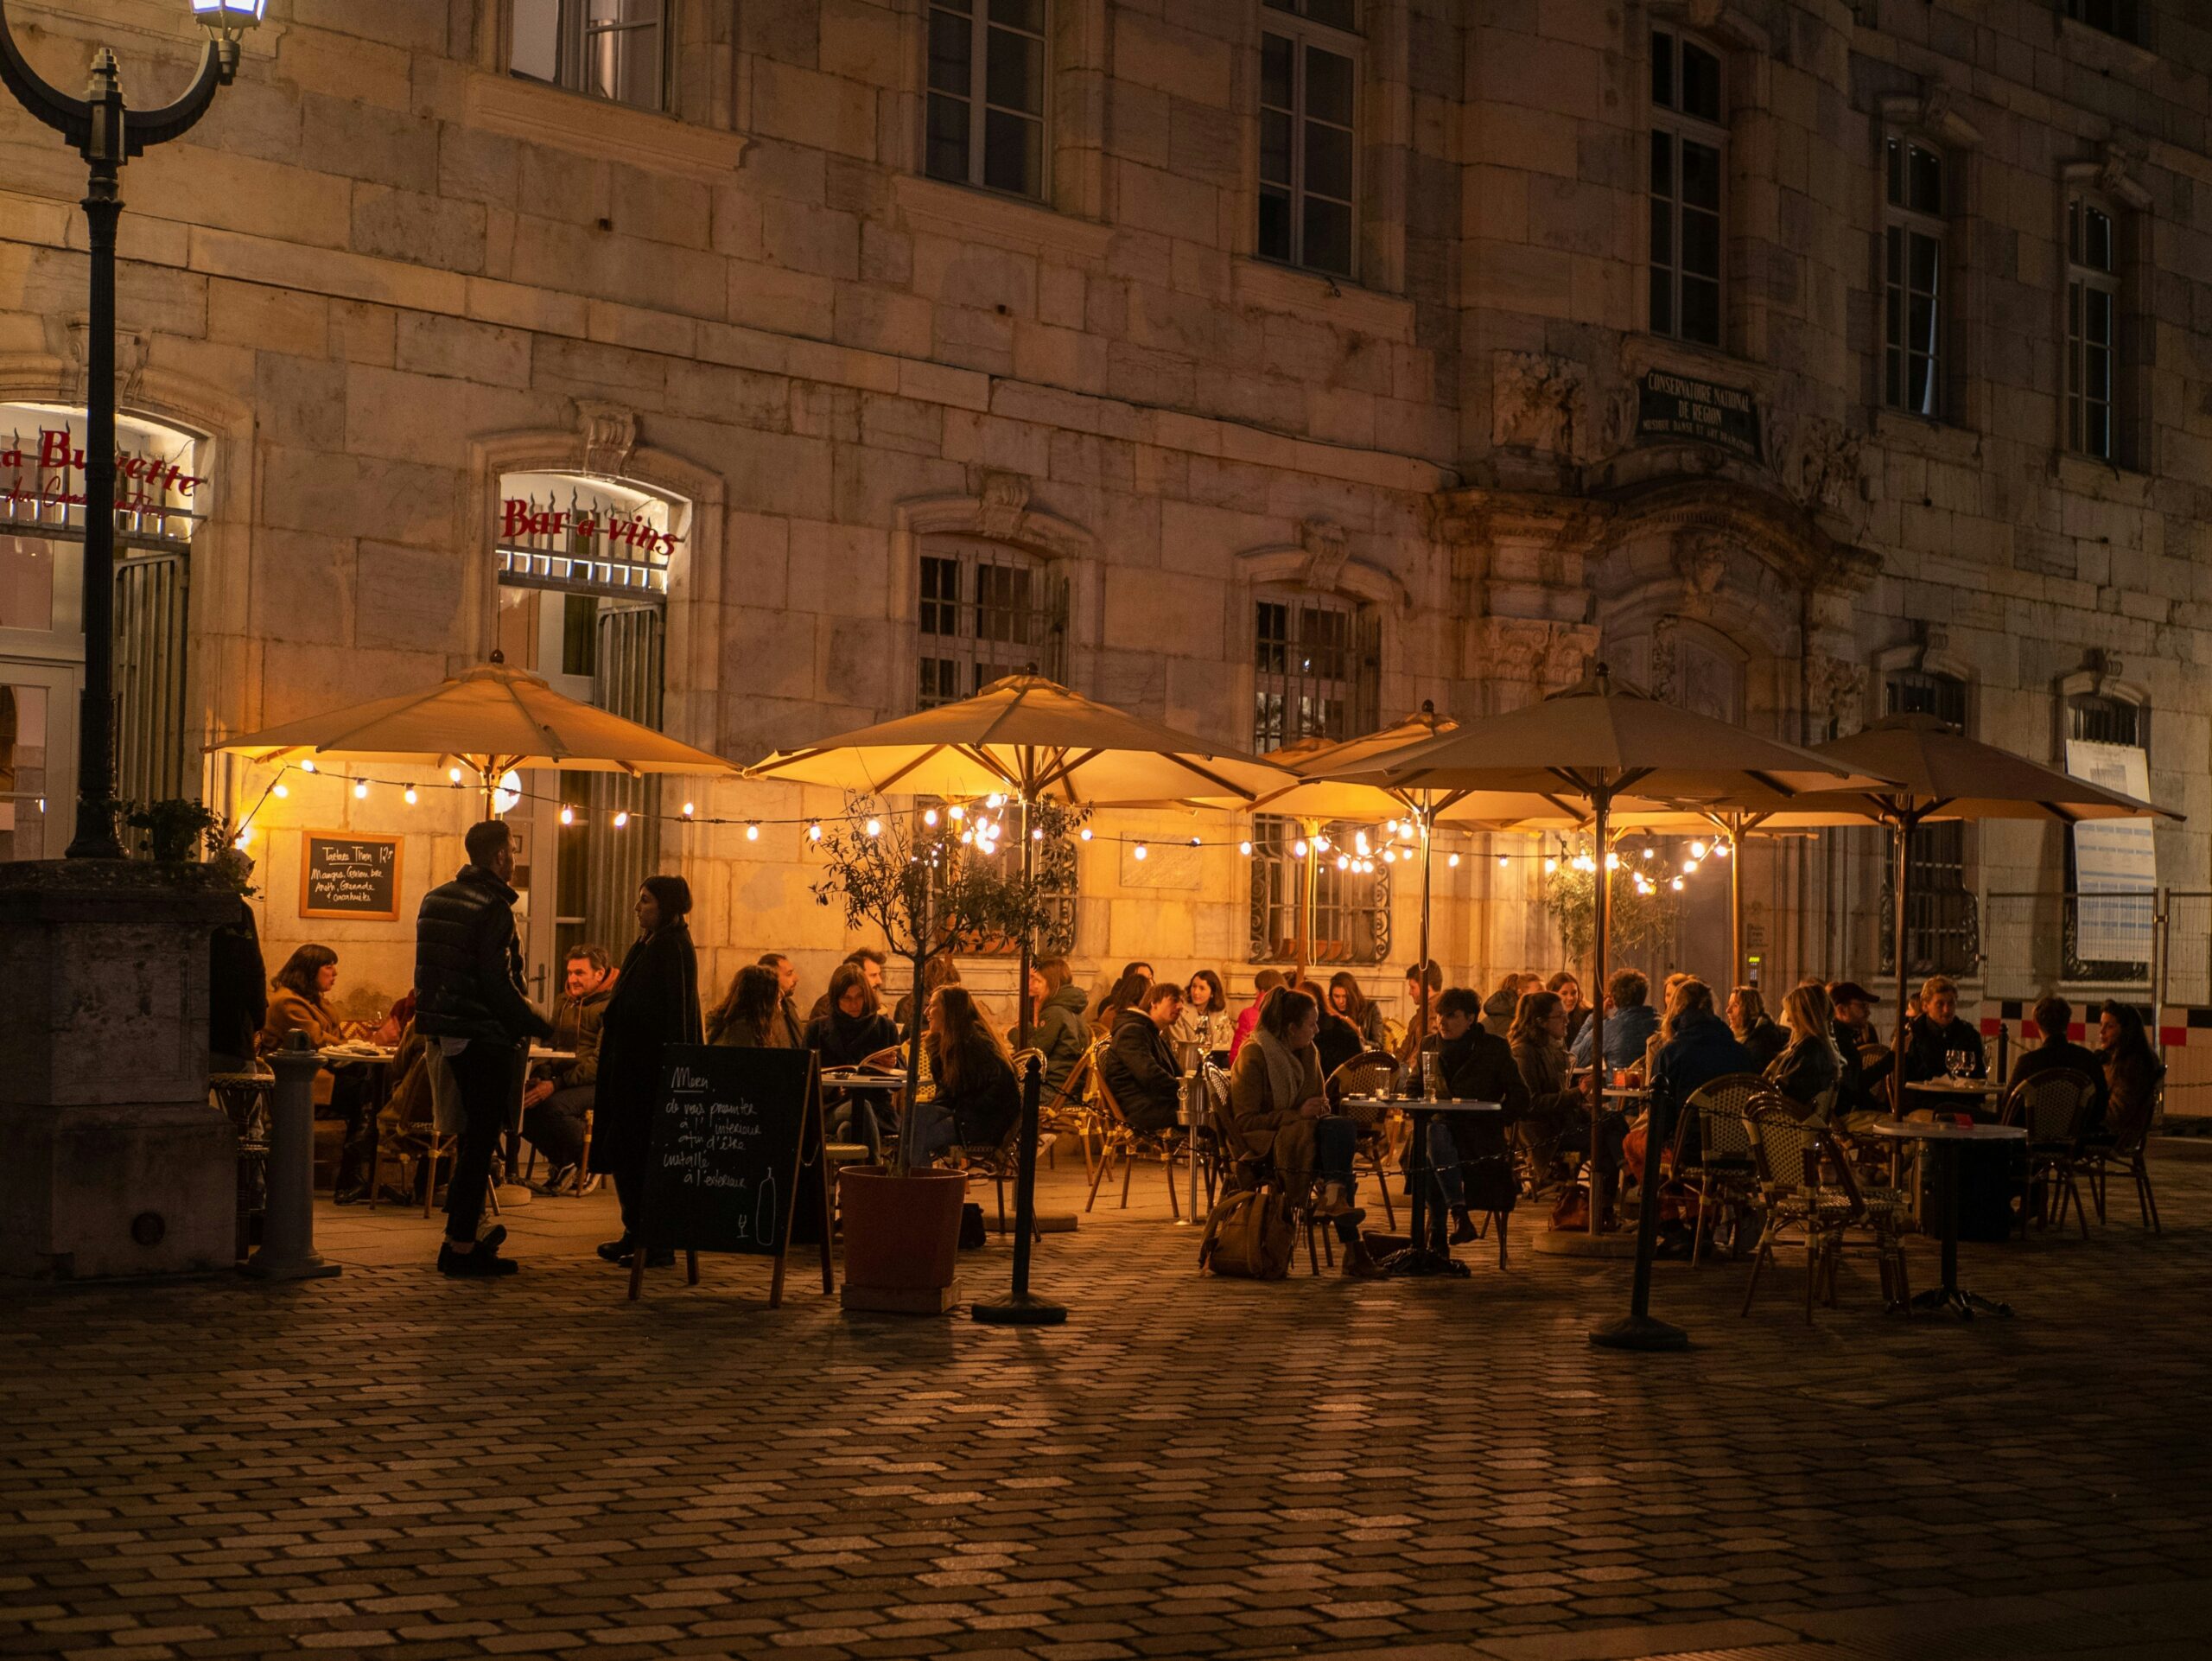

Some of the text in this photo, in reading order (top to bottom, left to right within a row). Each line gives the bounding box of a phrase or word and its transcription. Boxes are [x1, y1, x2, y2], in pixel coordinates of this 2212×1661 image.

[1648, 372, 1750, 412] CONSERVATOIRE NATIONAL
[1678, 399, 1689, 419] DE
[0, 449, 22, 468] a
[502, 499, 571, 538] Bar
[608, 515, 681, 556] vins
[665, 1098, 679, 1114] de
